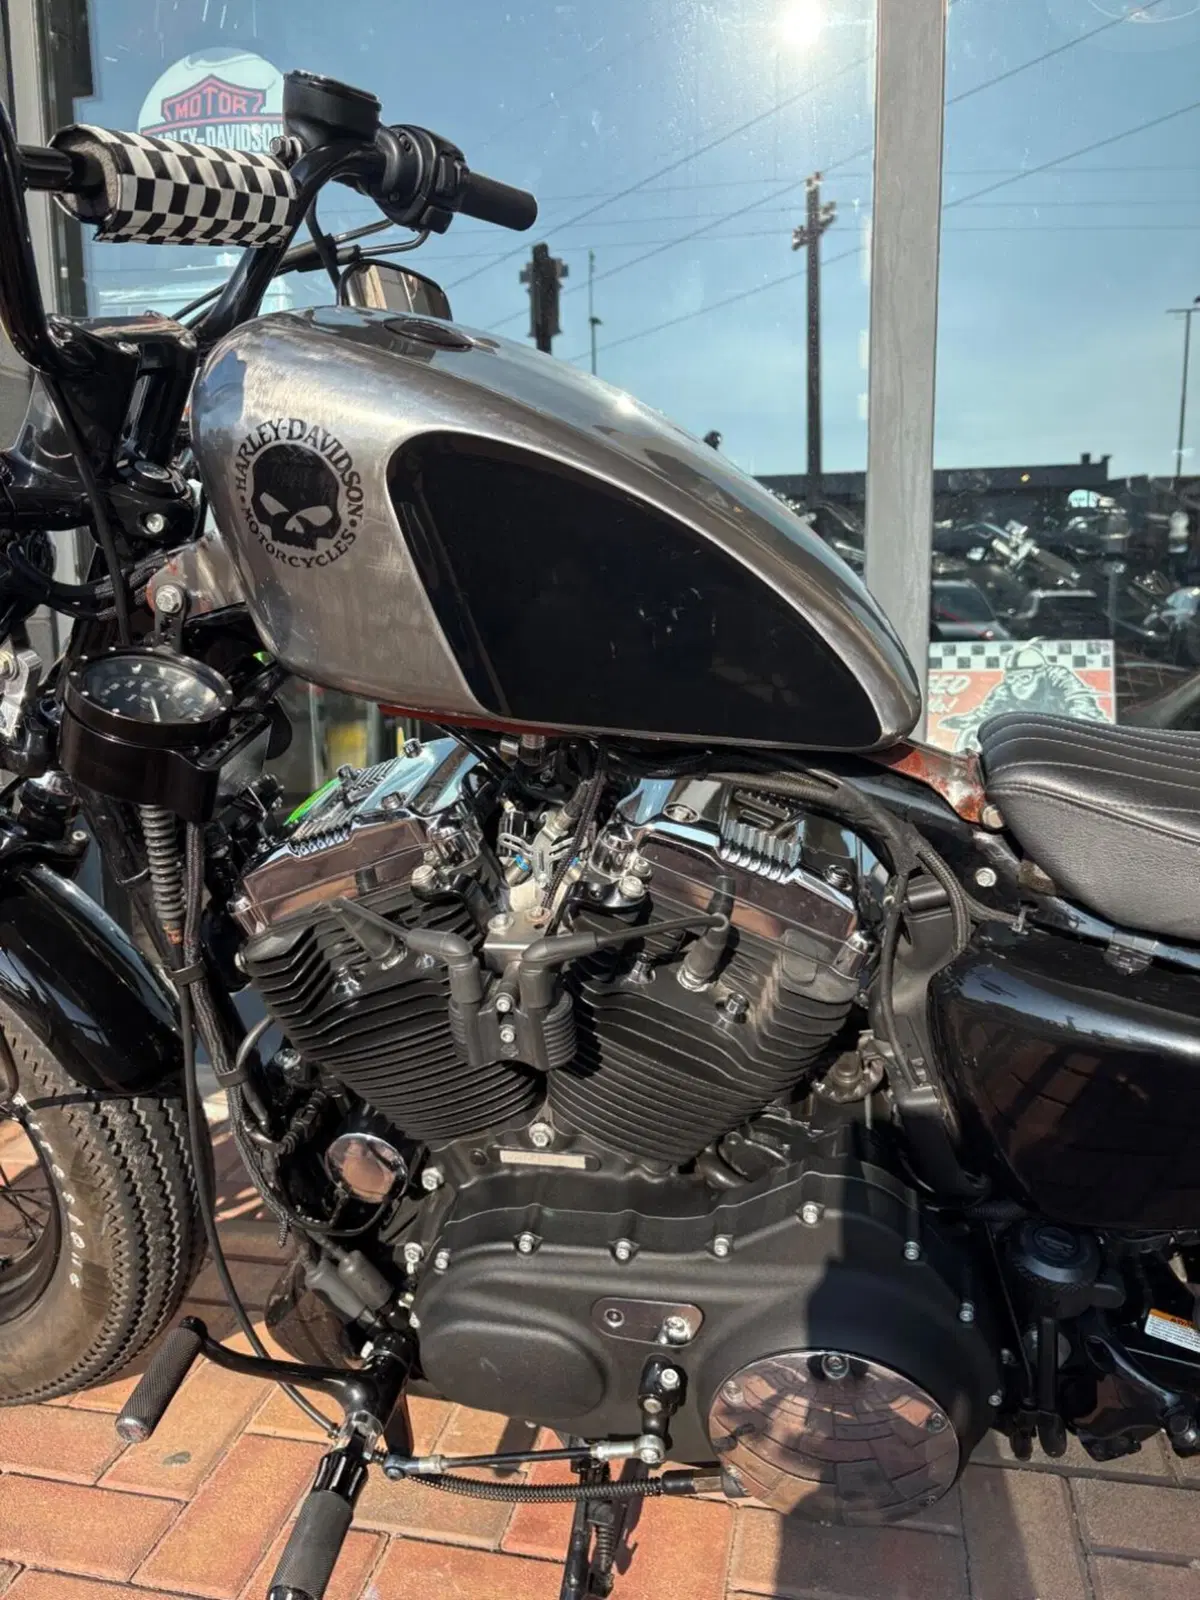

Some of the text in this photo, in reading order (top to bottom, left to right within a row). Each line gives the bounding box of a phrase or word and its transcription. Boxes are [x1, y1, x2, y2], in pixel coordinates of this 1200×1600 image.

[175, 86, 248, 120] MOTOR
[153, 123, 284, 153] EY-DAVIDSO
[235, 418, 364, 520] HARLEY-DAVIDSON
[241, 507, 357, 568] MOTORCYCLES
